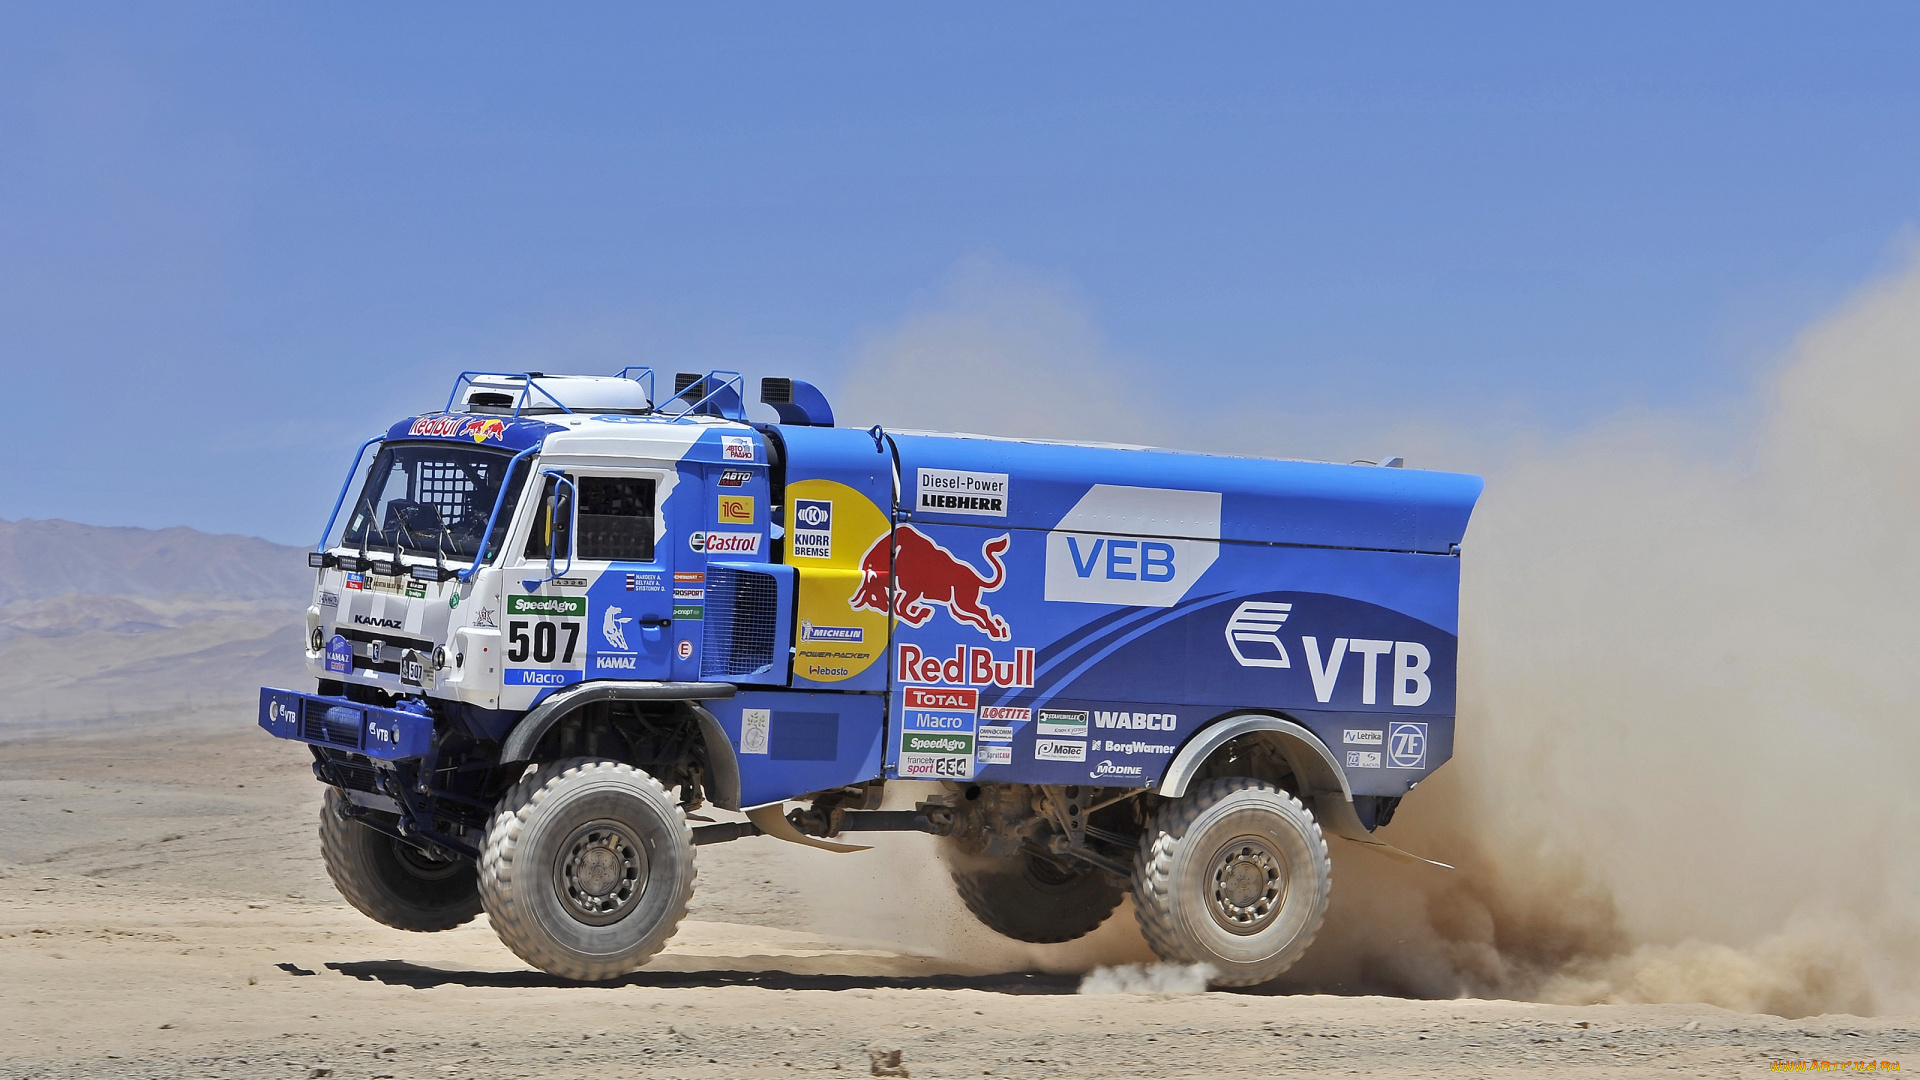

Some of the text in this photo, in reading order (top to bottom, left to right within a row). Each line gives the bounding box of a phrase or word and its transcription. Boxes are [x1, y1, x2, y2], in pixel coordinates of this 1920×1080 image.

[922, 474, 1004, 492] Diesel-Power
[921, 494, 1002, 511] LIEBHERR
[706, 534, 756, 551] Castrol
[794, 533, 829, 546] KNORR
[794, 546, 829, 557] BREMSE
[1066, 536, 1176, 583] VEB
[515, 598, 578, 613] SpeedAgro
[354, 615, 402, 629] KAMAZ
[813, 629, 861, 638] MICHELIN
[508, 621, 580, 663] 507
[680, 643, 689, 655] E
[327, 651, 350, 663] KAMAZ
[596, 656, 636, 669] KAMAZ
[410, 662, 423, 679] 507
[809, 665, 849, 676] Webasto
[898, 643, 1035, 688] Red Bull
[1302, 635, 1432, 706] VTB
[522, 671, 565, 683] Macro
[913, 691, 968, 707] TOTAL
[284, 710, 296, 723] VTB
[982, 708, 1030, 719] LOCTITE
[1094, 710, 1177, 731] WABCO
[916, 713, 962, 729] Macro
[376, 728, 389, 742] VTB
[1357, 731, 1382, 740] Letrika
[910, 737, 966, 751] SpeedAgro
[1105, 740, 1175, 755] BorgWarner
[1394, 733, 1422, 758] ZF
[907, 764, 934, 774] sport
[1097, 765, 1142, 775] MODINE
